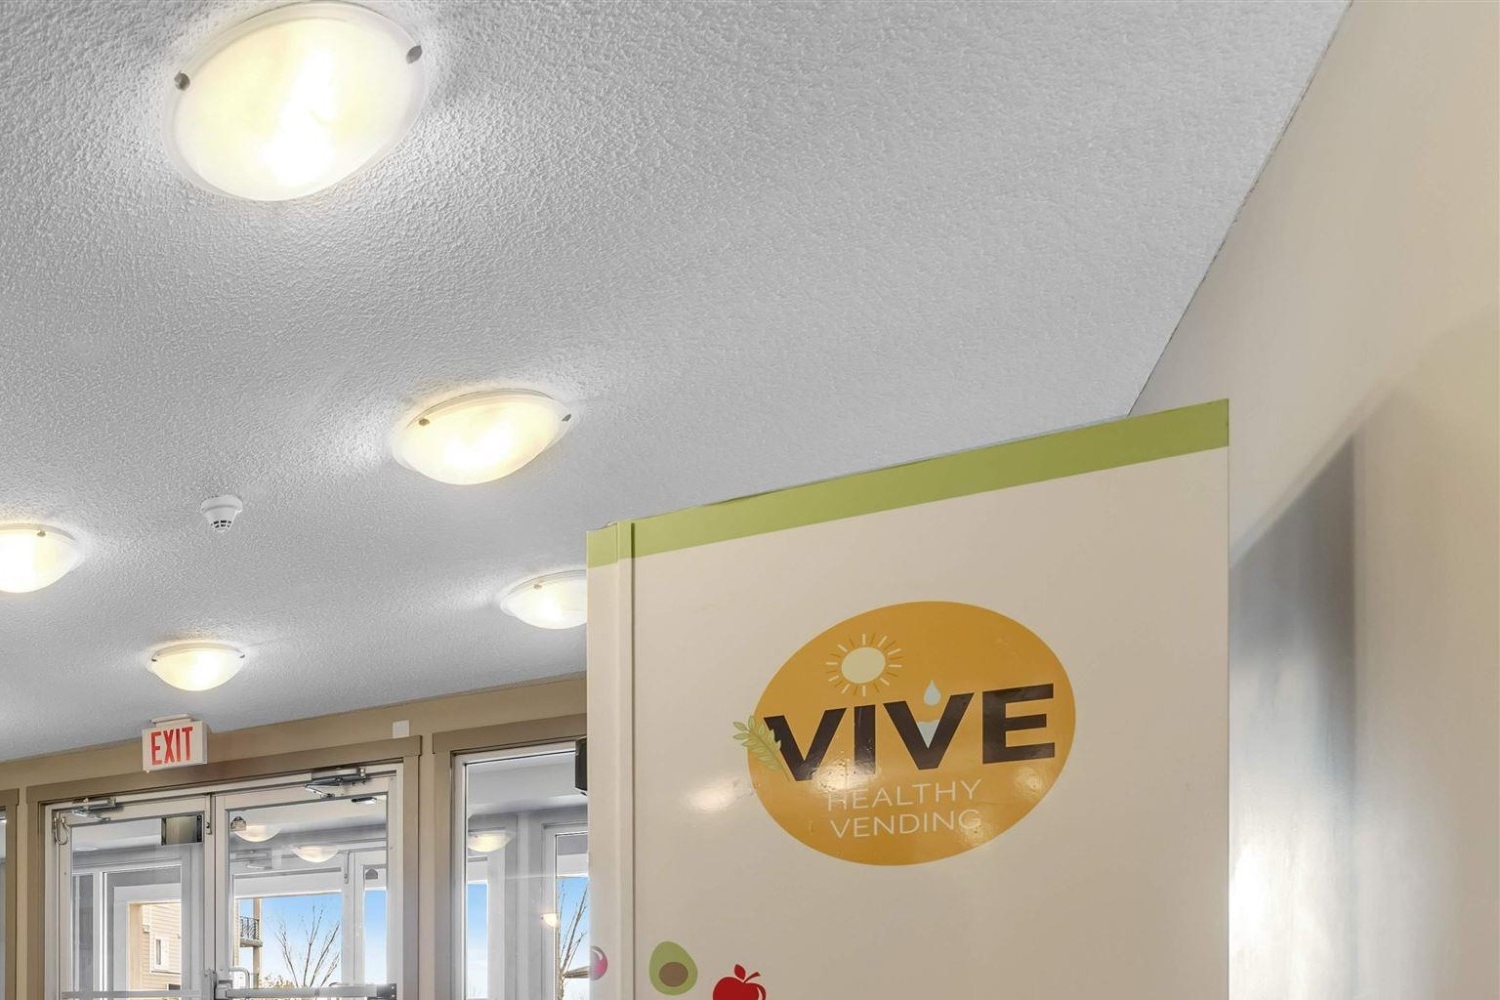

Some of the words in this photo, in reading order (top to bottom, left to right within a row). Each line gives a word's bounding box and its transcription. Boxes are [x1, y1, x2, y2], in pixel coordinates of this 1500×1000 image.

[151, 727, 193, 765] EXIT
[763, 683, 1056, 782] VIVE
[827, 778, 982, 812] HEALTHY
[830, 808, 982, 839] VENDING
